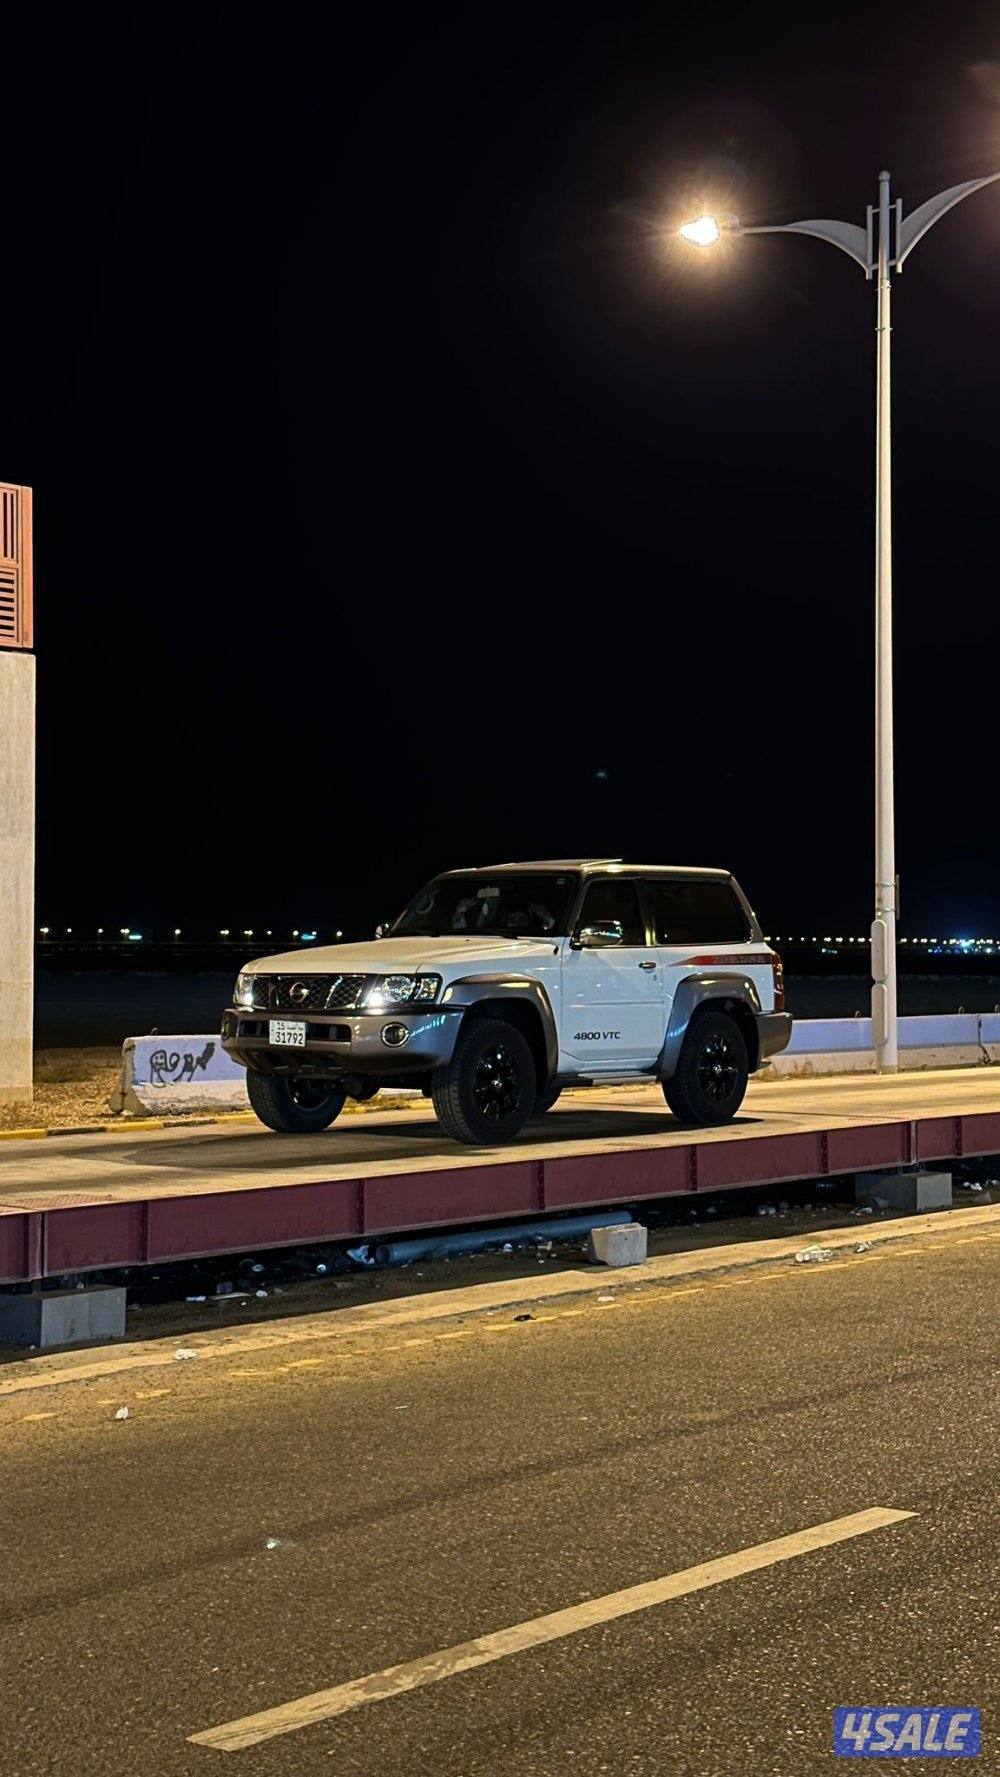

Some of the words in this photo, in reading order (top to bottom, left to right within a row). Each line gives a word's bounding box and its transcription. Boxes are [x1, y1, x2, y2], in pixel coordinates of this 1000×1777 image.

[277, 1021, 286, 1031] 15
[275, 1031, 304, 1045] 31792
[573, 1031, 601, 1040] 4800
[602, 1031, 621, 1040] VTC
